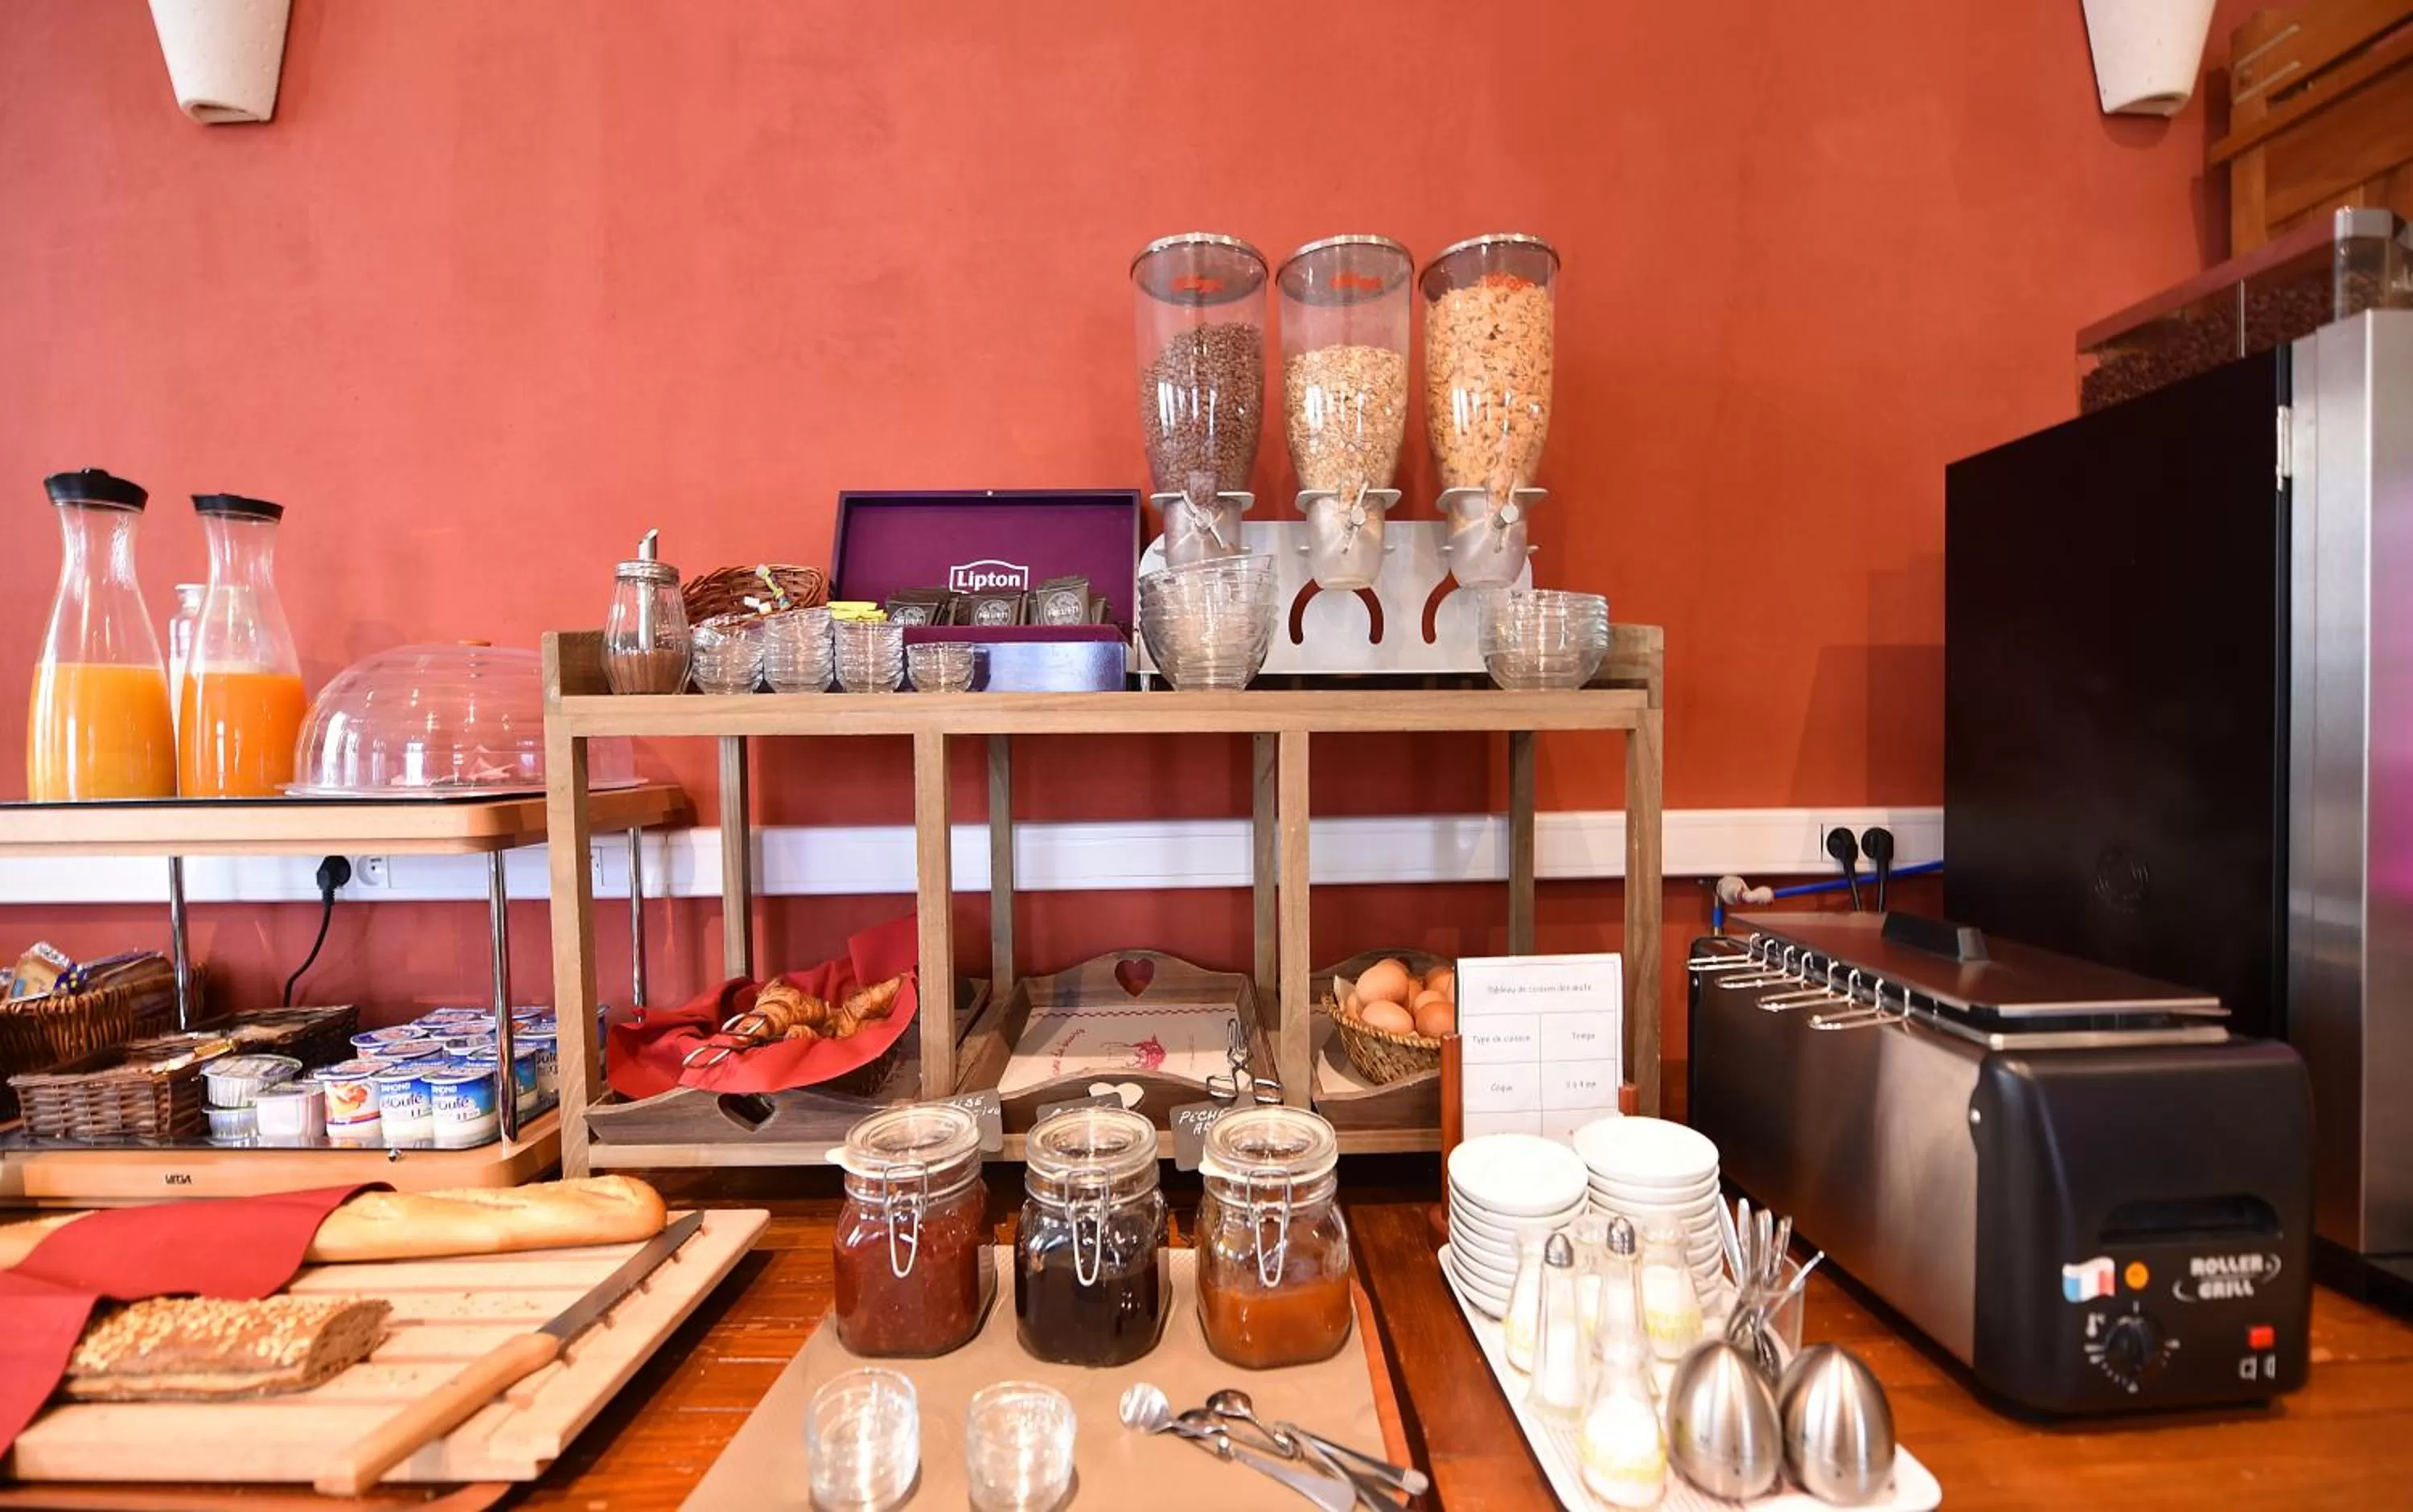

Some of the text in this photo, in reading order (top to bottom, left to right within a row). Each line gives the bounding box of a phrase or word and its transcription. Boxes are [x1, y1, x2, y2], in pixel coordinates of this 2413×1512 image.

[956, 570, 1022, 593] Lipton
[2189, 1253, 2264, 1277] ROLLER
[2197, 1279, 2255, 1300] GRILL
